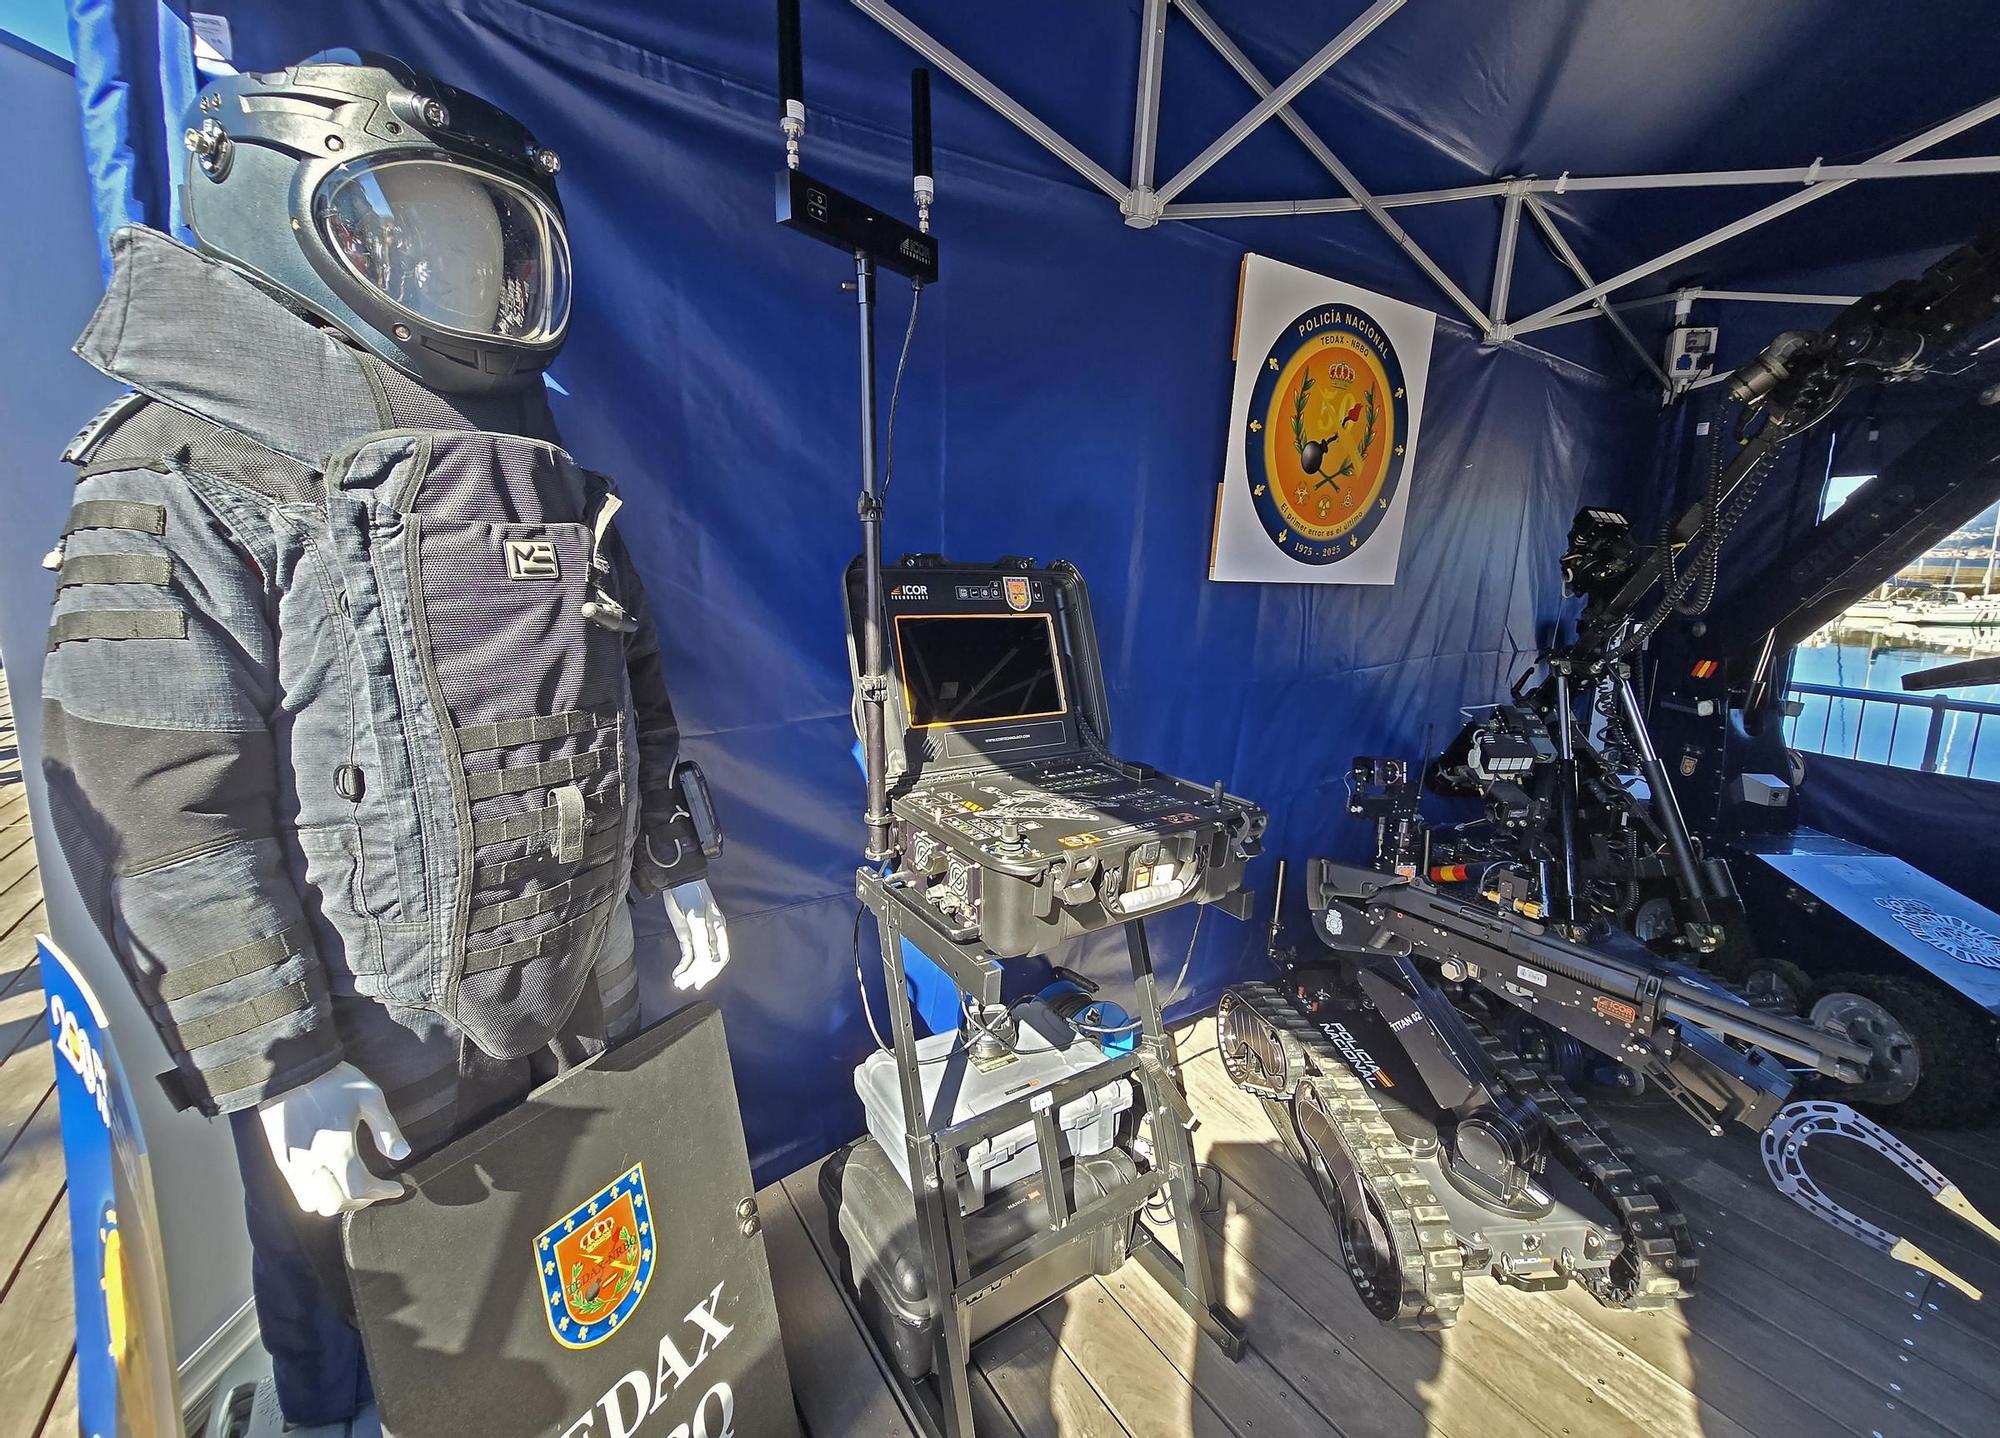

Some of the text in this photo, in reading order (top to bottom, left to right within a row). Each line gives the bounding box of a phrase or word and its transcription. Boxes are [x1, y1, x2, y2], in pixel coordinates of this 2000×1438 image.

[1299, 309, 1389, 359] POLICÍA NACIONAL
[1320, 335, 1345, 346] TEDAX
[1350, 340, 1370, 358] NRBQ
[1281, 503, 1289, 513] El
[1287, 513, 1307, 532] primer
[1308, 527, 1325, 537] error
[1326, 529, 1335, 537] es
[1294, 542, 1313, 556] 1975
[1322, 545, 1341, 557] 2025
[902, 584, 928, 595] ICOR
[1389, 1011, 1423, 1033] TITAN 02
[1610, 1001, 1633, 1016] ICOR
[1320, 1022, 1377, 1089] NACIONAL
[1331, 1022, 1381, 1074] POLICIA
[667, 1382, 735, 1438] Q
